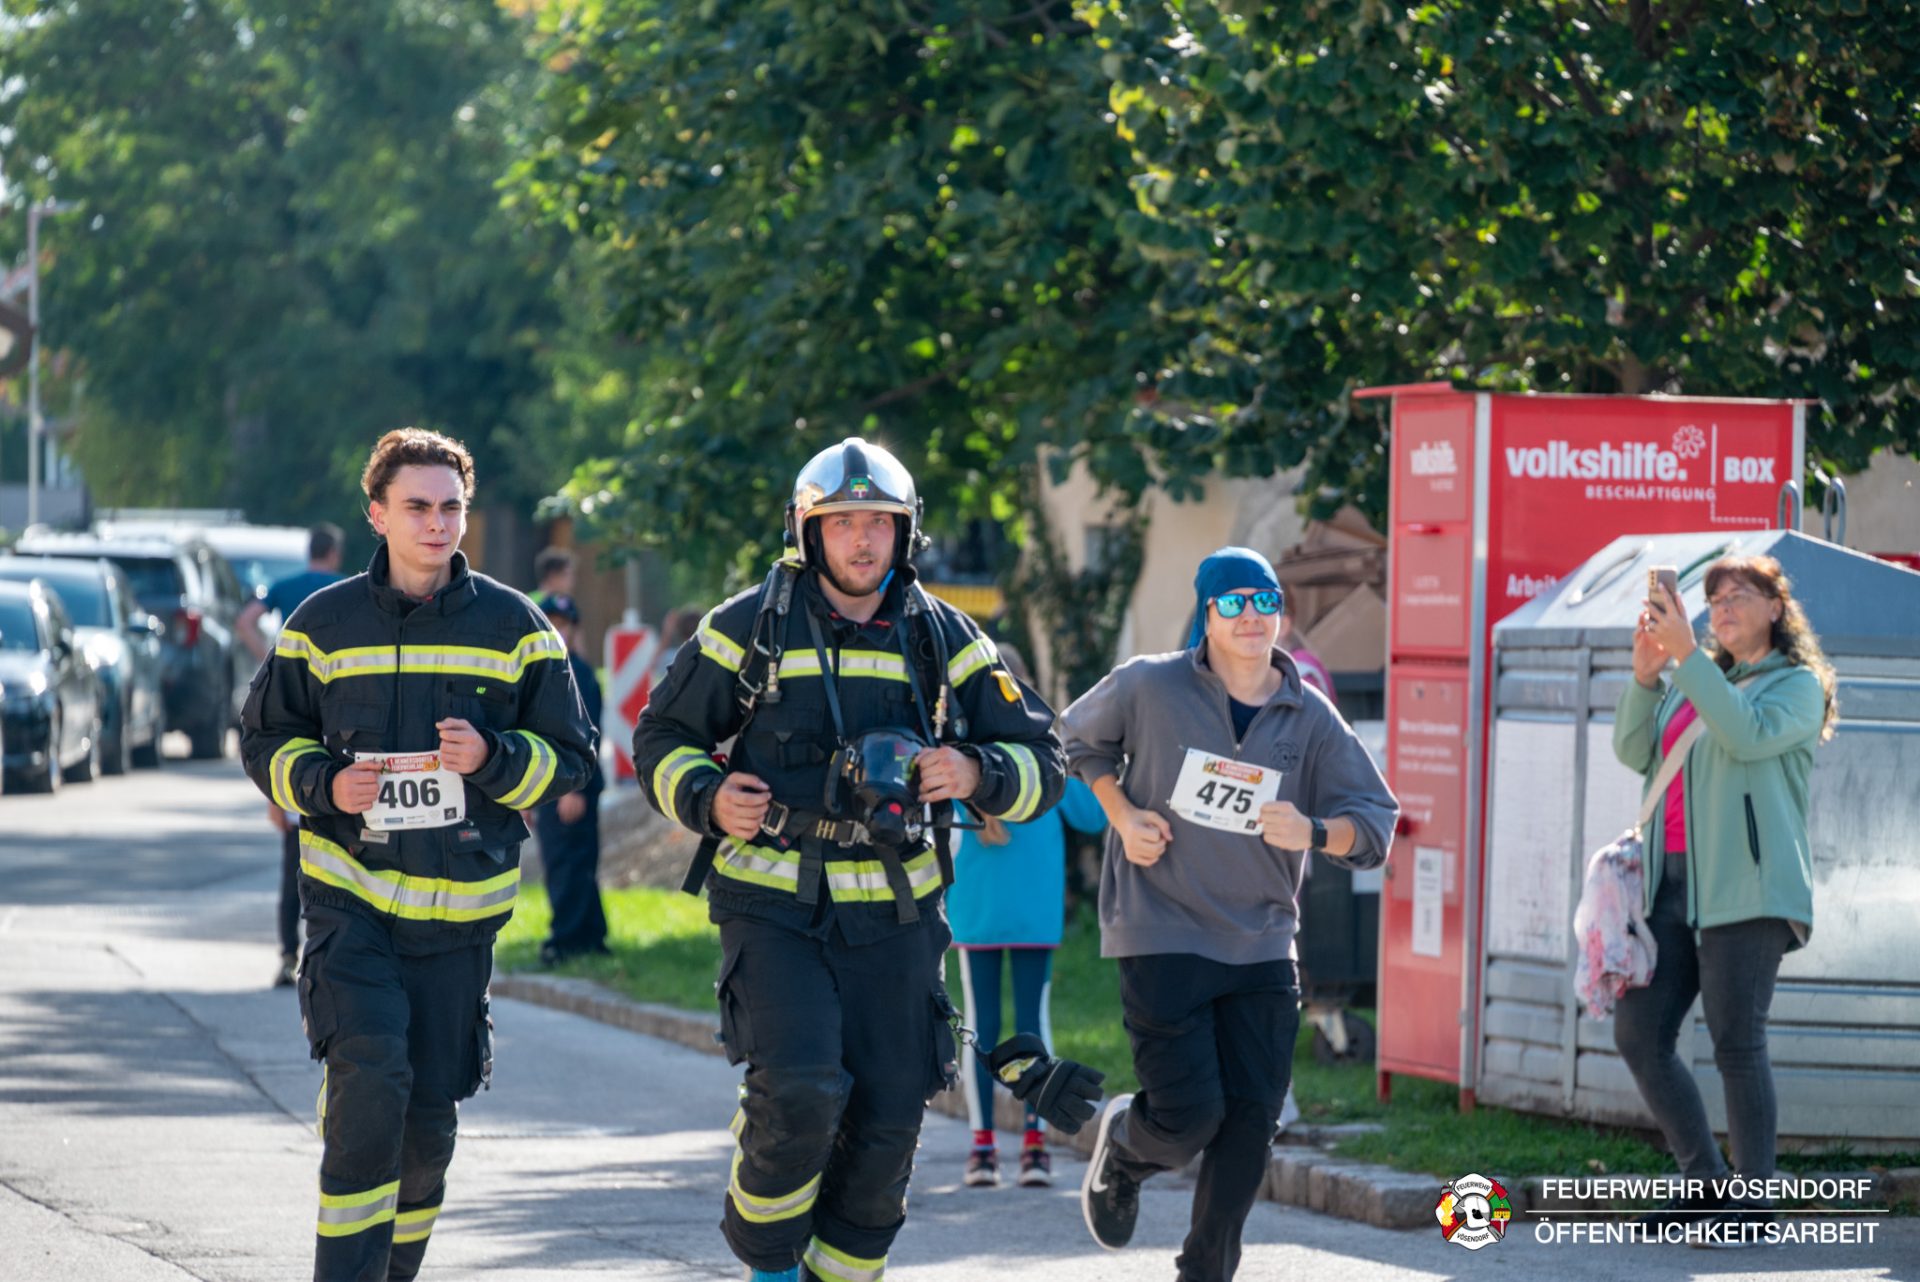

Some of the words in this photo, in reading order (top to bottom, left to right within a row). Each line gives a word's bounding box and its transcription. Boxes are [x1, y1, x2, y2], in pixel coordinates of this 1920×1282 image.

[1723, 456, 1776, 483] BOX
[1585, 484, 1717, 502] BESCHÄFTIGUNG
[378, 778, 441, 809] 406
[1196, 780, 1255, 814] 475
